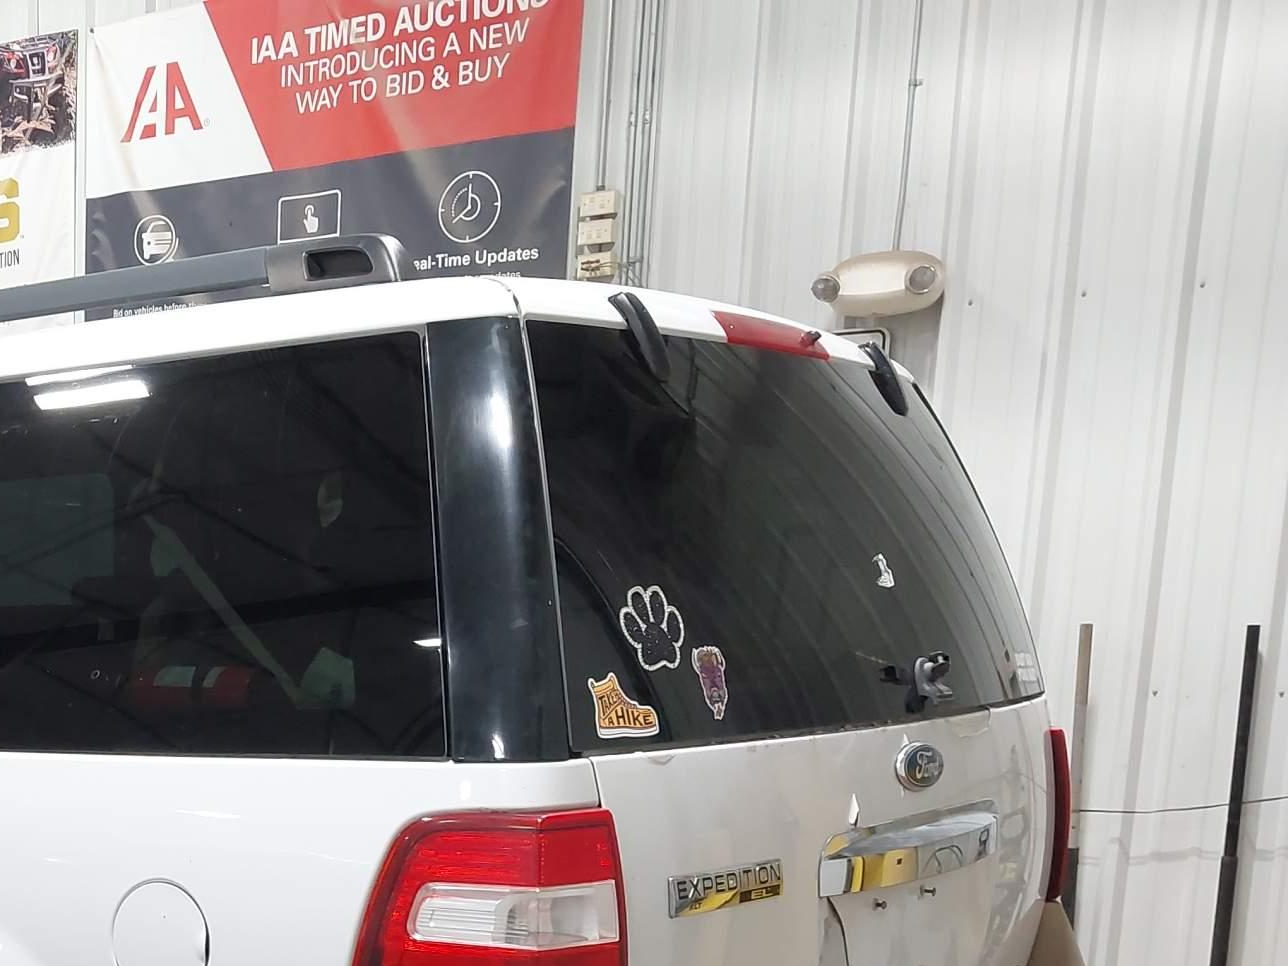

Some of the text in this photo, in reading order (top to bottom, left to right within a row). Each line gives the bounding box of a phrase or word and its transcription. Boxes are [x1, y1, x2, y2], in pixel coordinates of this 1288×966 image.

[250, 0, 549, 65] IAA TIMED AUCTIO
[280, 17, 530, 87] INTRODUCING A NEW
[296, 52, 511, 114] WAY TO BID & BUY
[413, 248, 539, 271] eal-Time Updates
[616, 706, 654, 726] HIKE
[676, 862, 781, 900] EXPEDITION
[752, 889, 770, 899] EL
